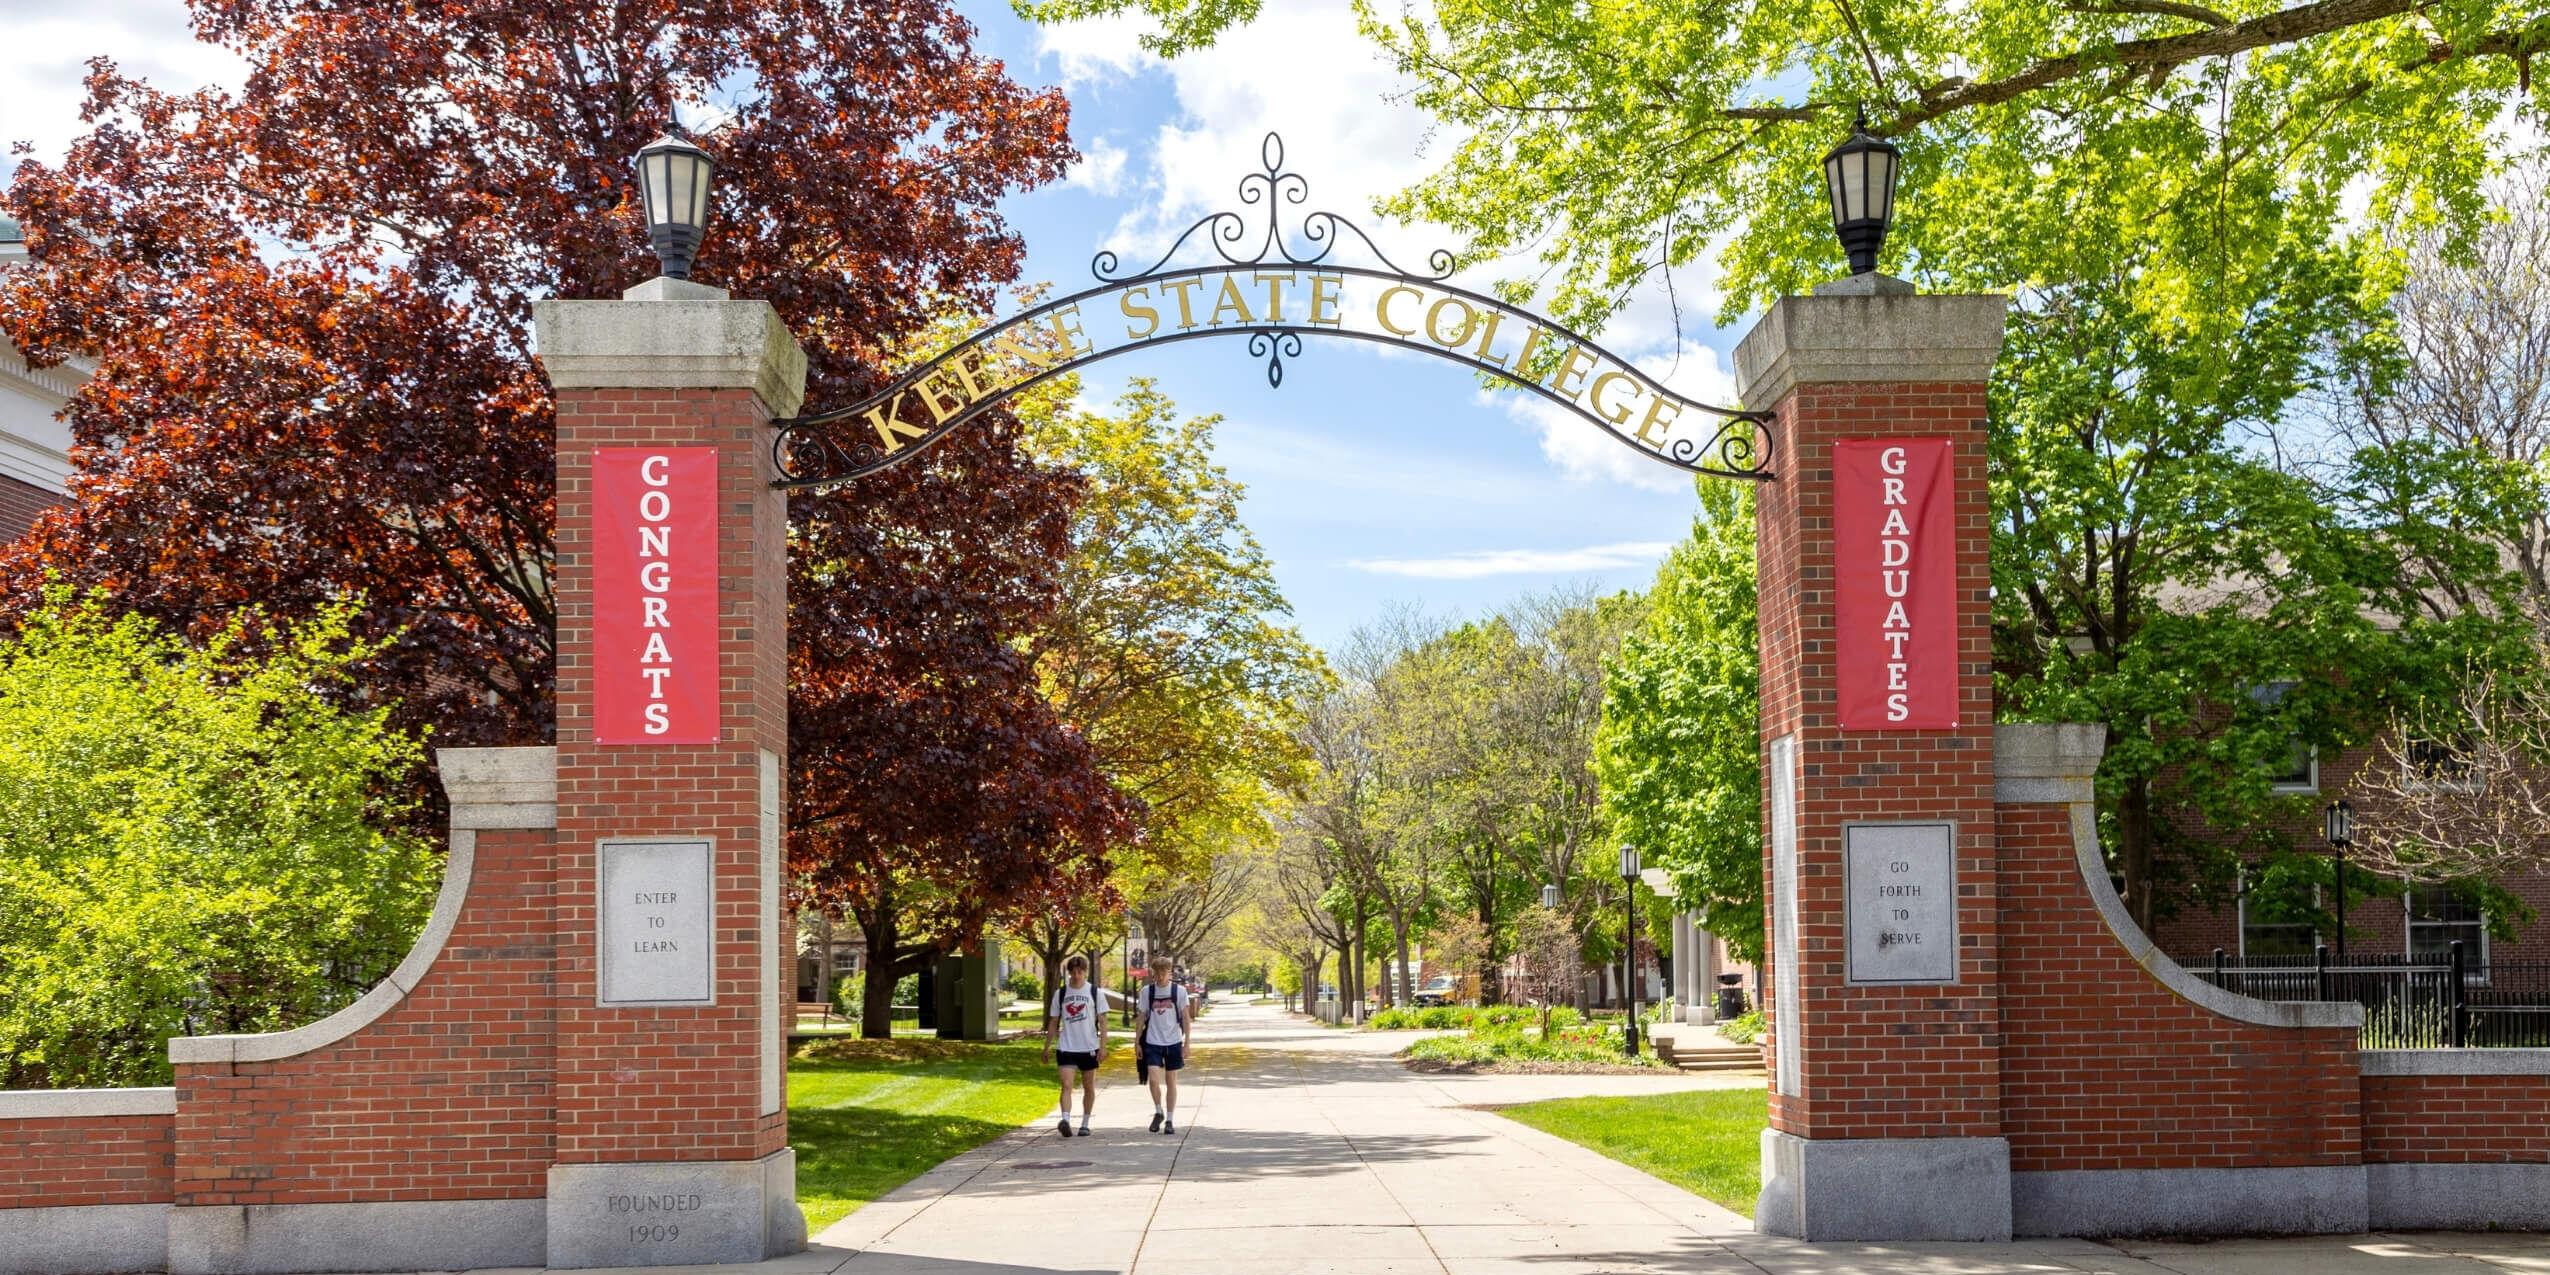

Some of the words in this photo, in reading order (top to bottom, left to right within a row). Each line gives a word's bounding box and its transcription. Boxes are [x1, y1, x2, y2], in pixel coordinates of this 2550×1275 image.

[862, 305, 1094, 456] KEENE
[1120, 274, 1343, 340] STATE
[1376, 286, 1683, 449] COLLEGE
[1880, 447, 1911, 722] GRADUATES
[638, 455, 672, 735] CONGRATS
[1890, 861, 1909, 873] GO
[1879, 885, 1921, 897] FORTH
[635, 892, 677, 905] ENTER
[1891, 909, 1909, 921] TO
[648, 916, 665, 929] TO
[1880, 932, 1922, 945] SERVE
[634, 941, 678, 953] LEARN
[608, 1194, 701, 1213] FOUNDED
[629, 1224, 680, 1242] 1909
